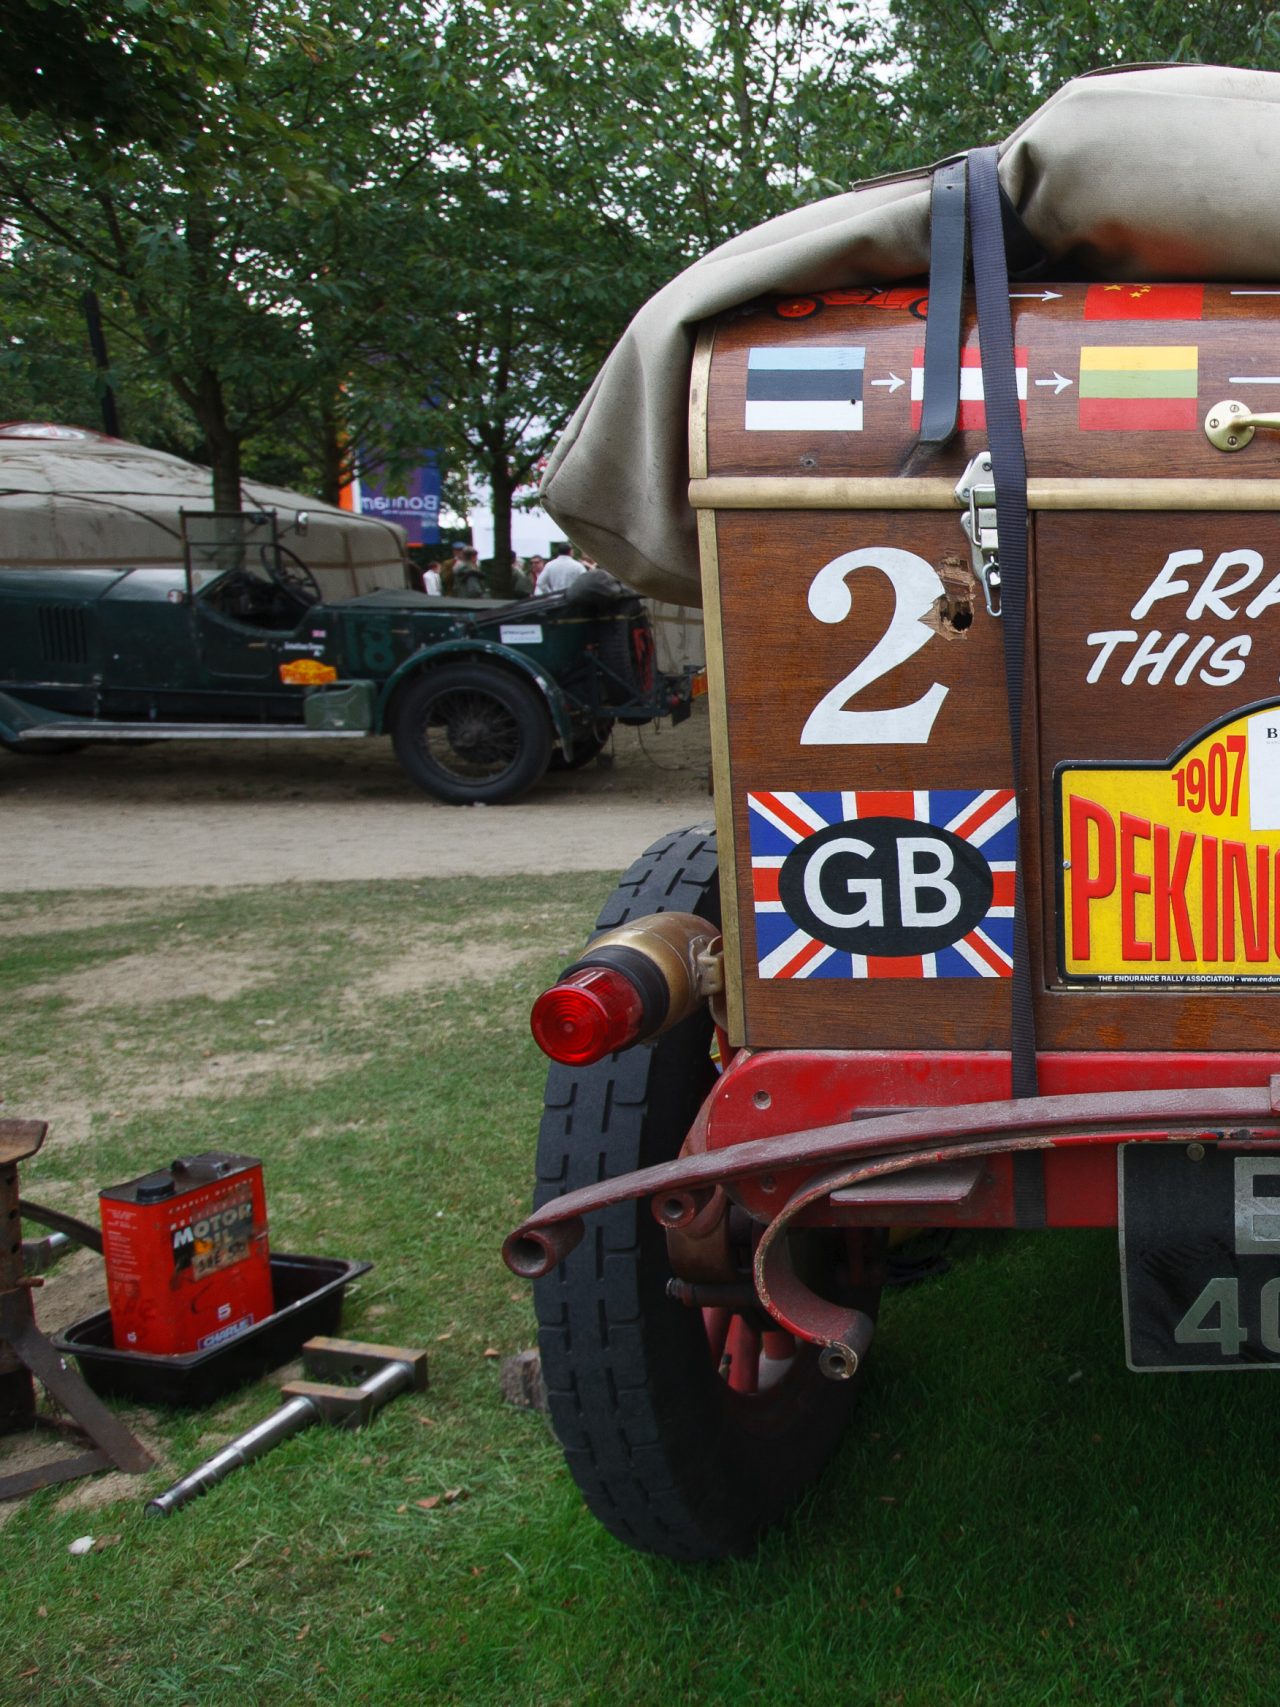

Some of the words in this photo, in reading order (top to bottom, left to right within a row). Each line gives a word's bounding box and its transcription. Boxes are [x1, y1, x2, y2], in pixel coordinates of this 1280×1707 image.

[800, 547, 949, 745] 2
[1087, 630, 1252, 687] THIS
[1172, 736, 1246, 817] 1907
[803, 837, 961, 929] GB
[1186, 975, 1235, 983] ASSOCIATION
[173, 1203, 252, 1249] MOTOR
